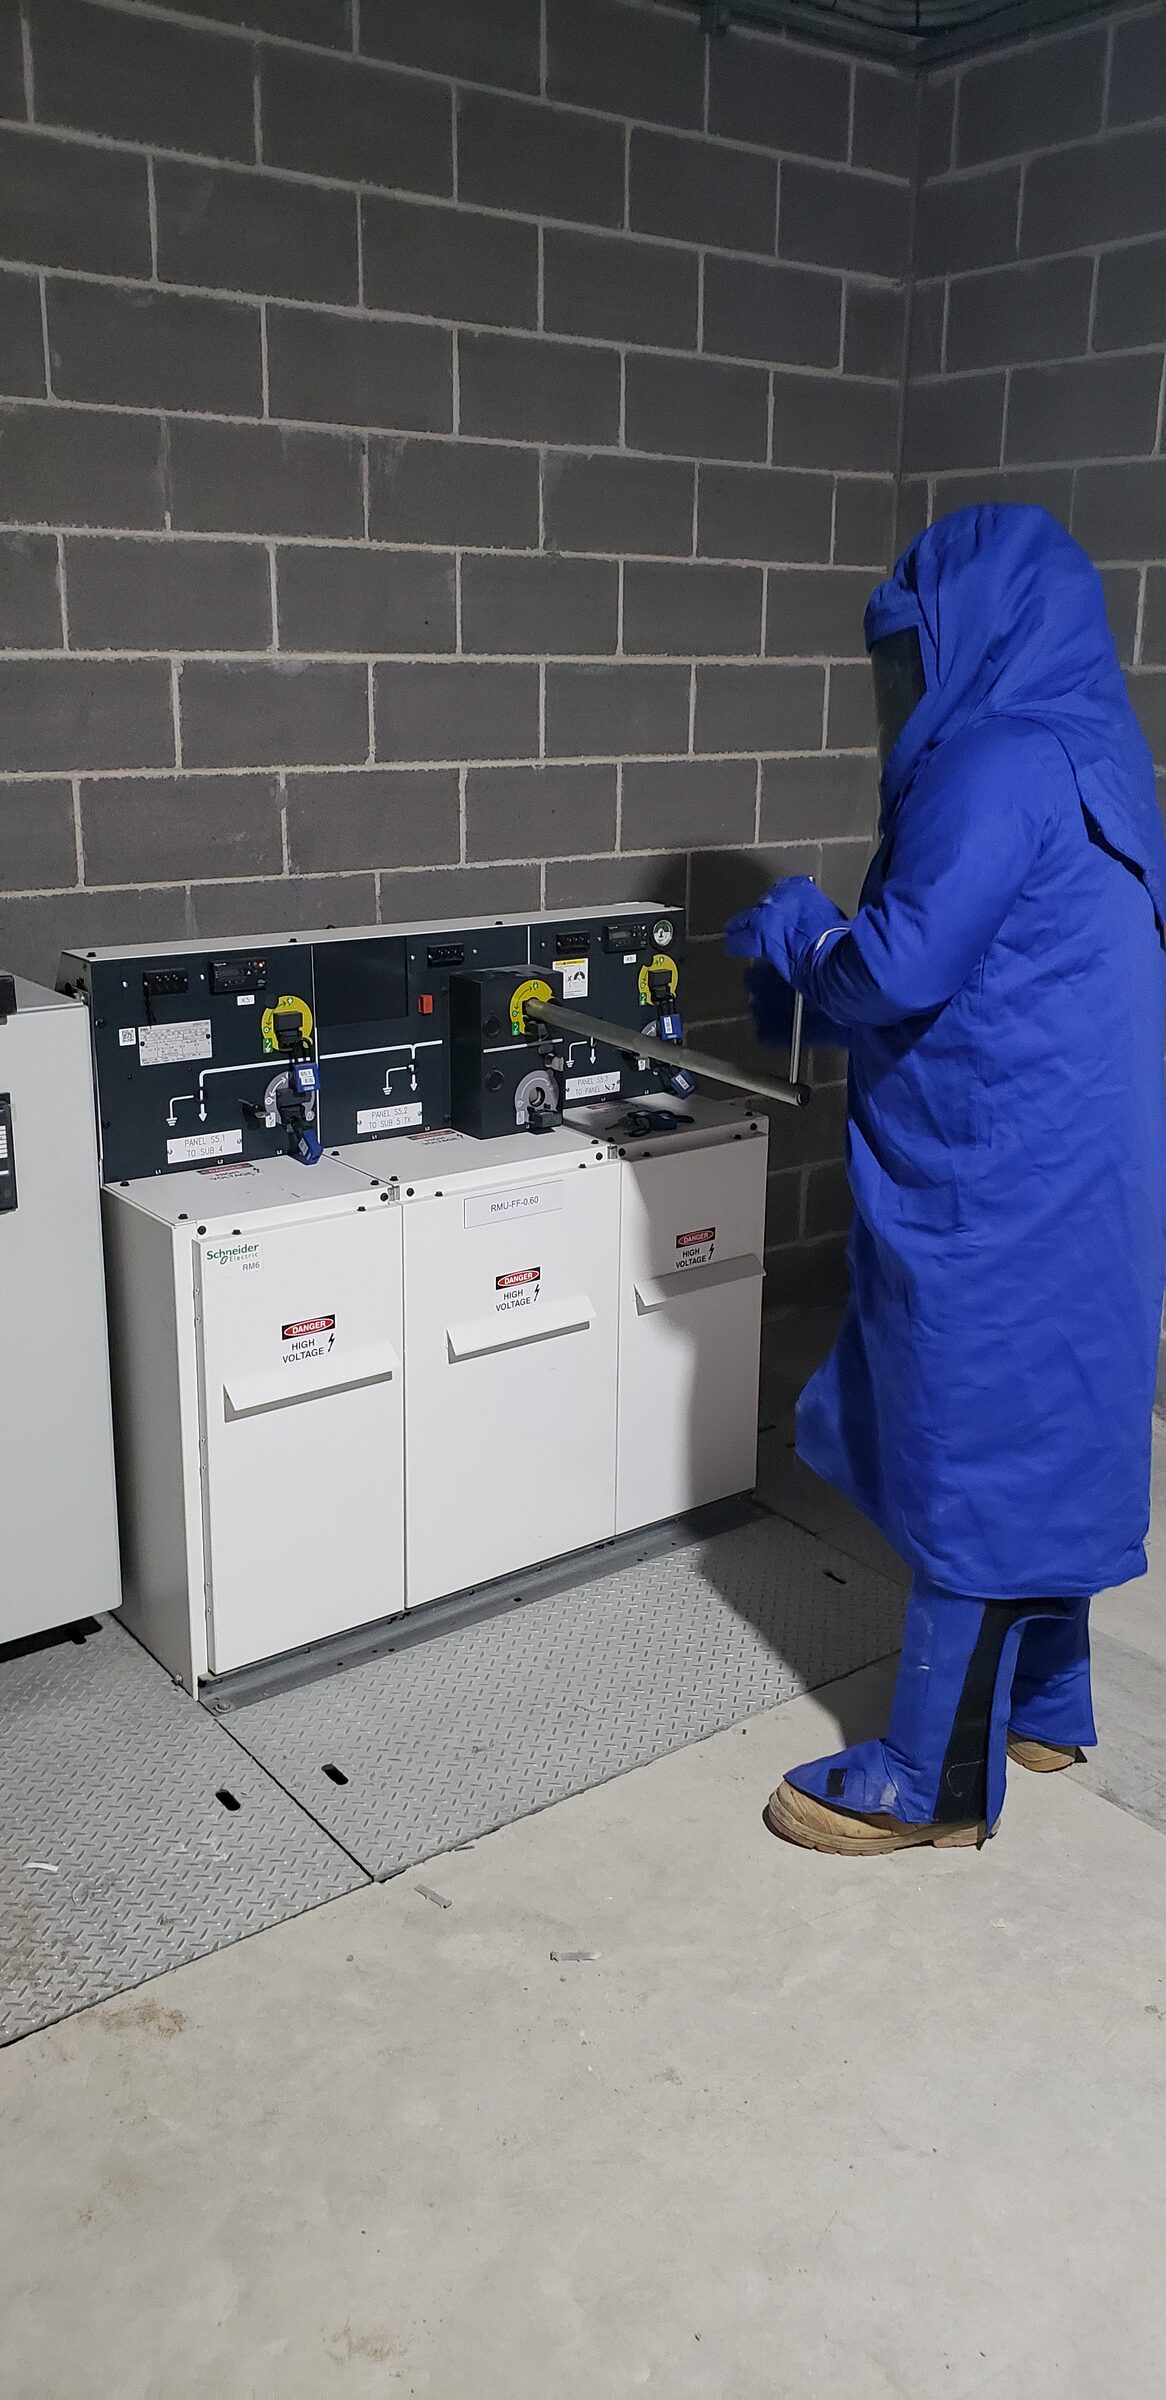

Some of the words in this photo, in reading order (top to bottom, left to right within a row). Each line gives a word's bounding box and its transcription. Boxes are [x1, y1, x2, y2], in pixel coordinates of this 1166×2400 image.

[371, 1110, 391, 1119] PANEL
[369, 1121, 377, 1129] TO
[380, 1119, 393, 1128] SUB
[404, 1116, 412, 1124] TX
[184, 1137, 207, 1147] PANEL
[187, 1149, 196, 1157] TO
[200, 1146, 215, 1156] SUB
[490, 1196, 539, 1212] RMU-FF-0.60
[683, 1232, 709, 1243] DANGER
[206, 1244, 259, 1260] Schneider
[229, 1252, 258, 1262] Electric
[682, 1248, 700, 1258] HIGH
[242, 1262, 260, 1271] RM6
[675, 1255, 707, 1269] VOLTAGE
[504, 1272, 533, 1285] DANGER
[503, 1289, 524, 1300] HIGH
[495, 1297, 531, 1312] VOLTAGE
[292, 1320, 326, 1334] DANGER
[291, 1339, 315, 1351] HIGH
[282, 1347, 324, 1364] VOLTAGE
